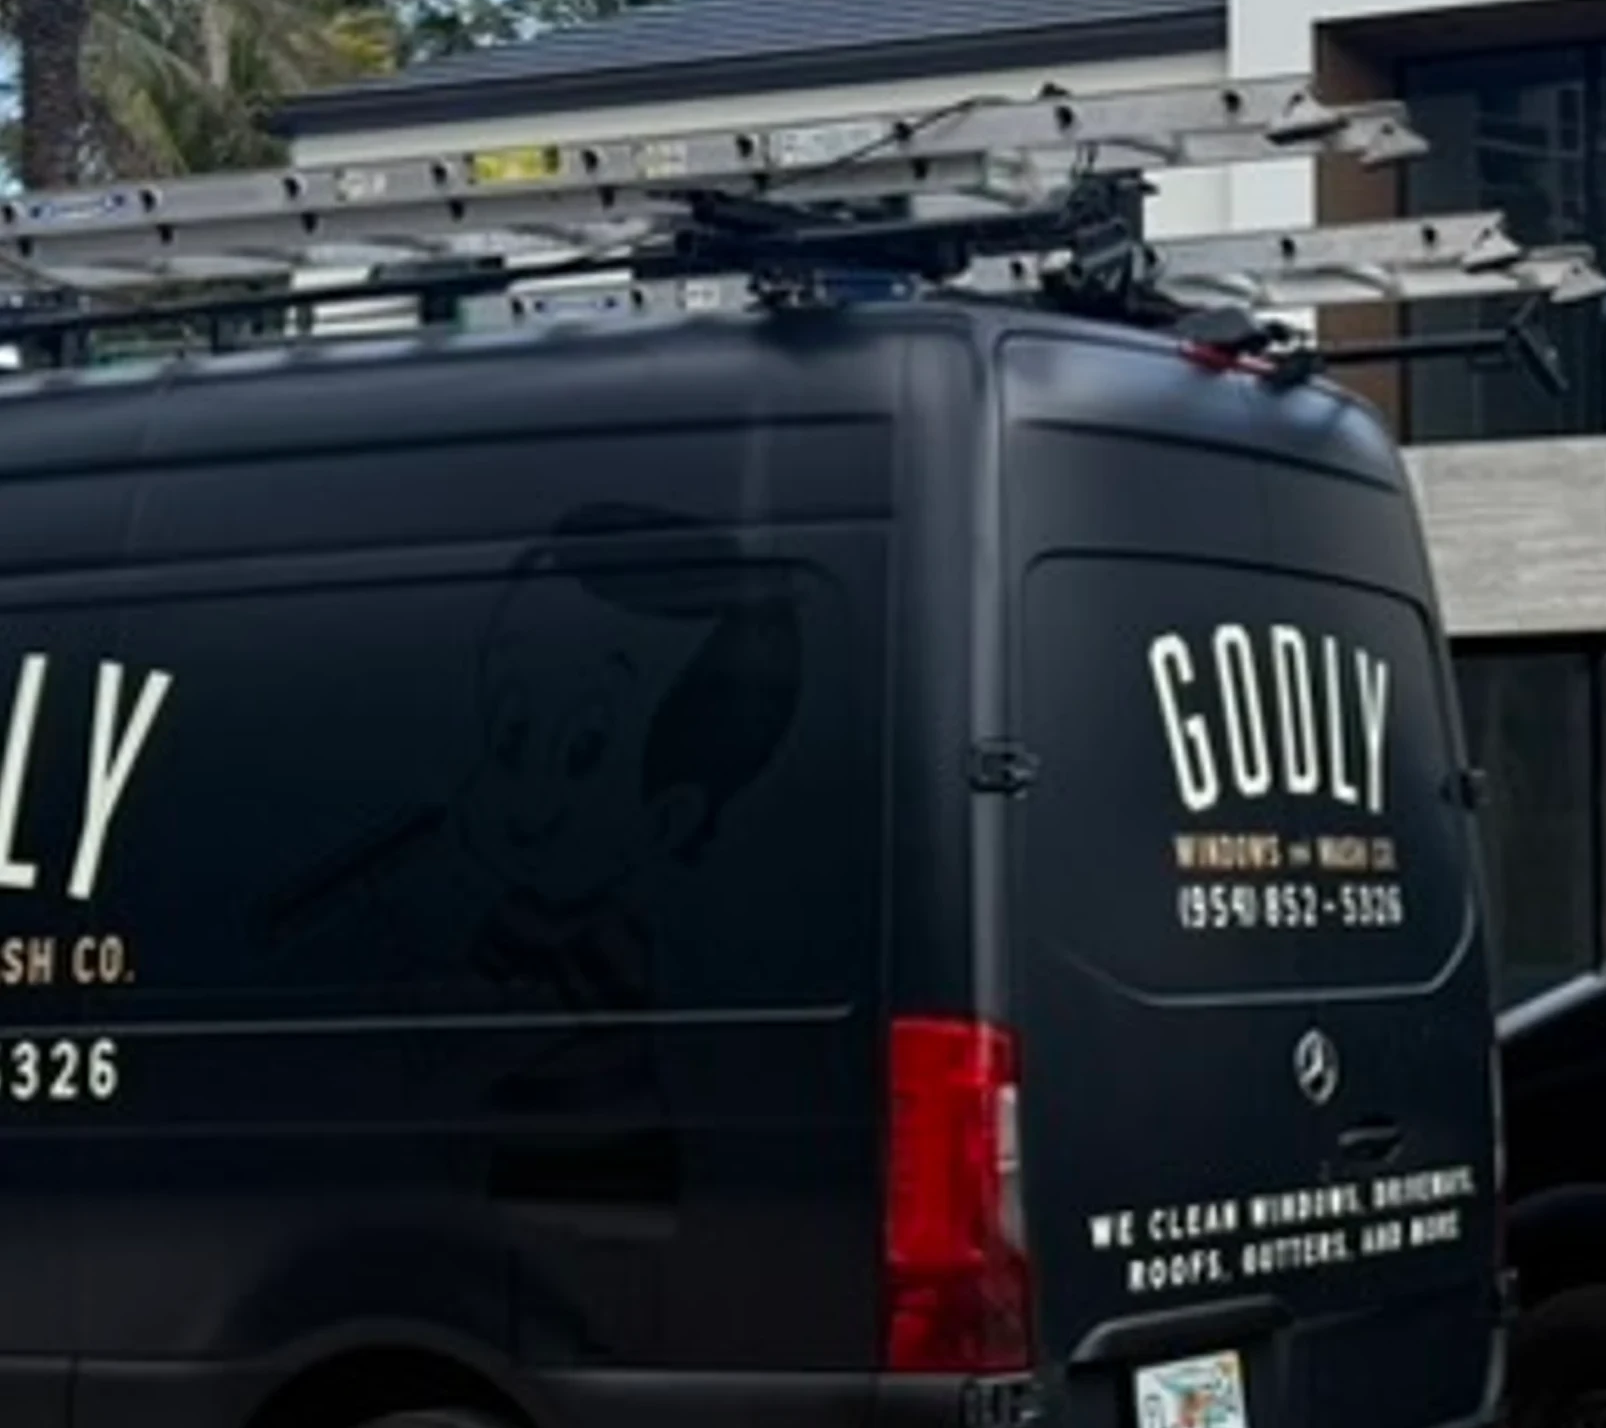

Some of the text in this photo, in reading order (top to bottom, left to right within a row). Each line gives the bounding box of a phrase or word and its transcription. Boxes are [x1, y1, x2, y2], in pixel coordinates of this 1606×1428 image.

[1148, 622, 1389, 814] GODLY
[1178, 885, 1258, 927] (954)
[0, 935, 136, 985] SH CO.
[0, 1037, 119, 1102] 326
[1090, 1210, 1135, 1248] WE
[1148, 1198, 1239, 1241] CLEAN
